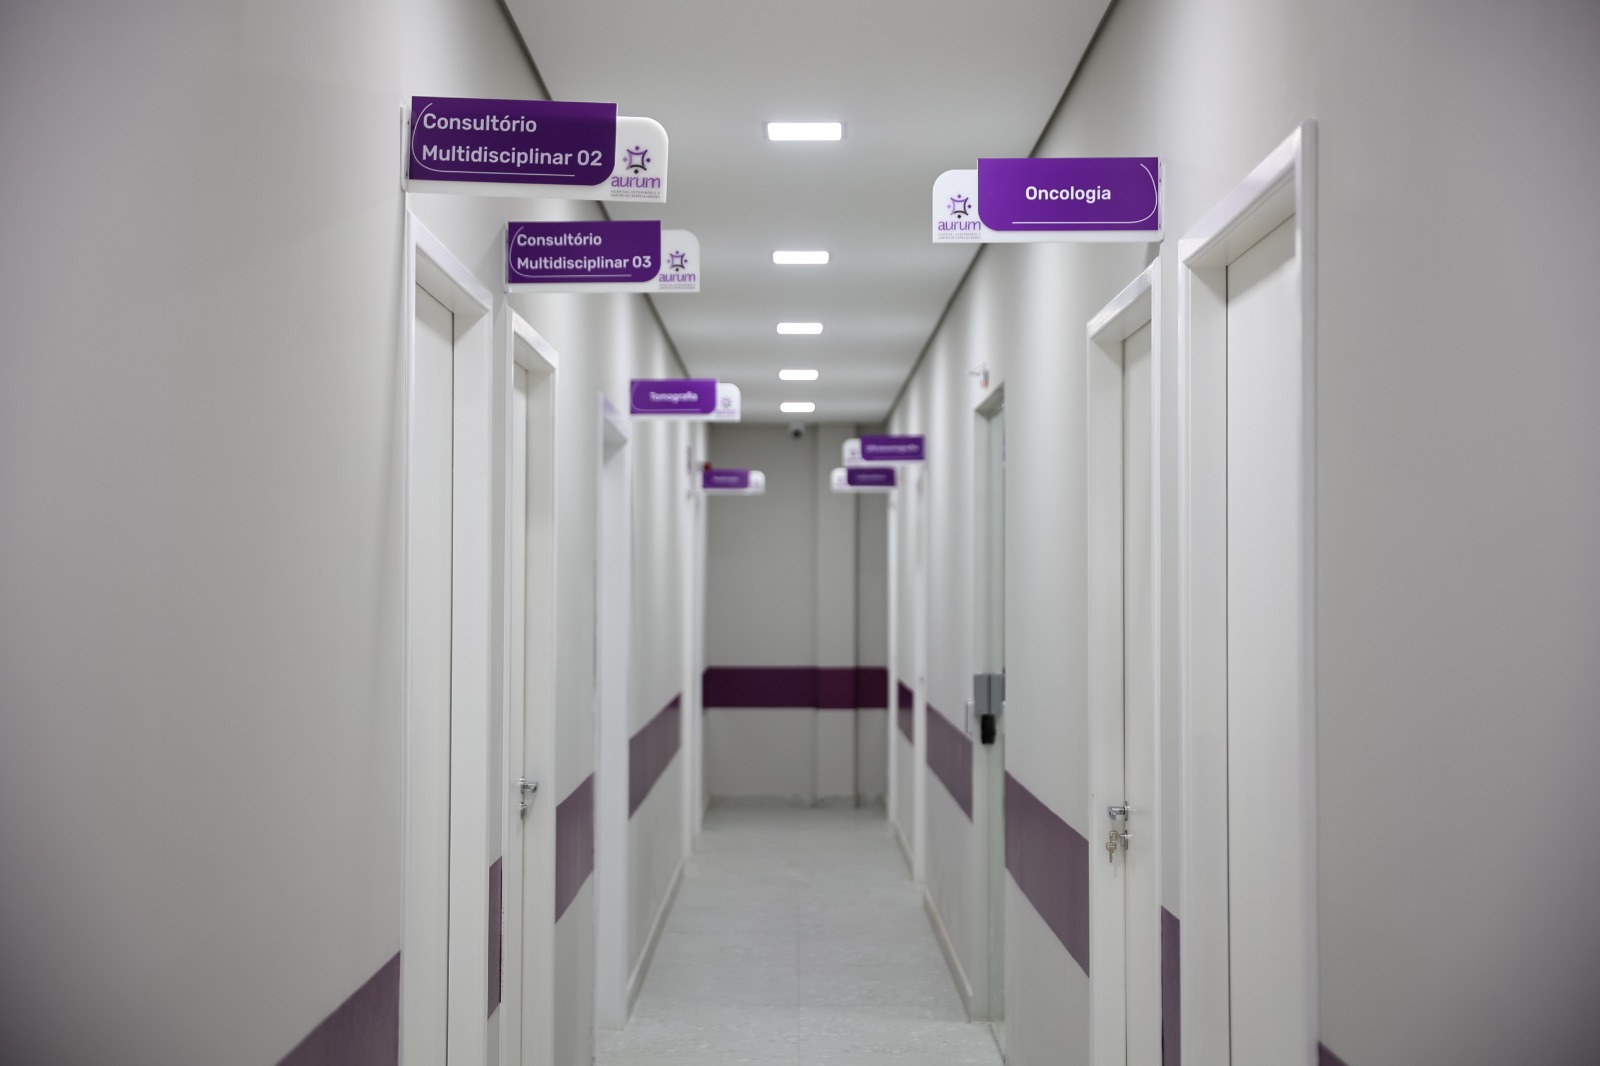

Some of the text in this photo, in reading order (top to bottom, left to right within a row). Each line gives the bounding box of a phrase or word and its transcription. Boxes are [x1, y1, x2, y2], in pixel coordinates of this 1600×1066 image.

[423, 113, 537, 132] Consultório
[422, 144, 602, 167] Multidisciplinar 02
[611, 176, 661, 188] aurum
[1026, 186, 1111, 203] Oncologia
[937, 221, 980, 231] aurum
[516, 233, 602, 246] Consultório
[516, 255, 652, 271] Multidisciplinar 03
[659, 273, 696, 284] aurum
